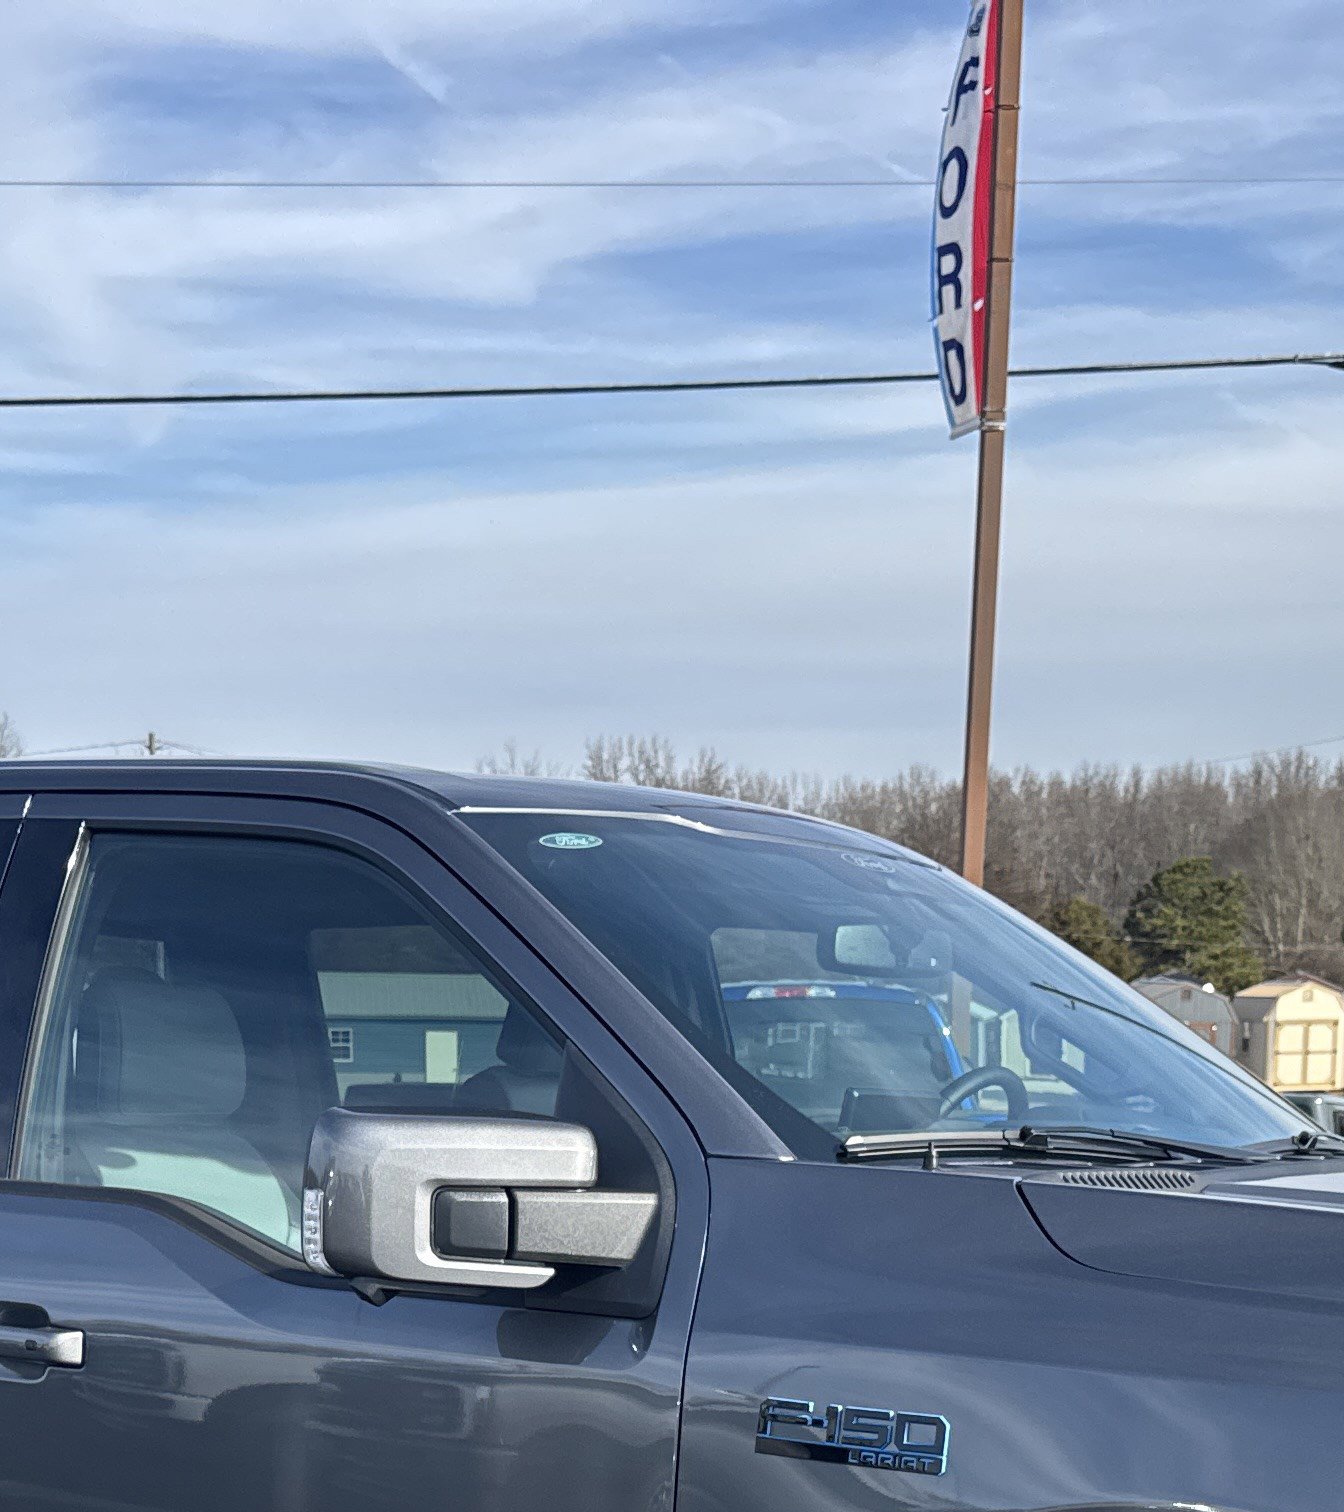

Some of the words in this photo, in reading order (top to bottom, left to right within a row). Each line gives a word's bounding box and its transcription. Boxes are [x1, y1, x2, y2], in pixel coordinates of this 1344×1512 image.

[936, 57, 979, 406] FORD
[757, 1396, 950, 1457] F-150
[848, 1449, 935, 1472] LARIAT
